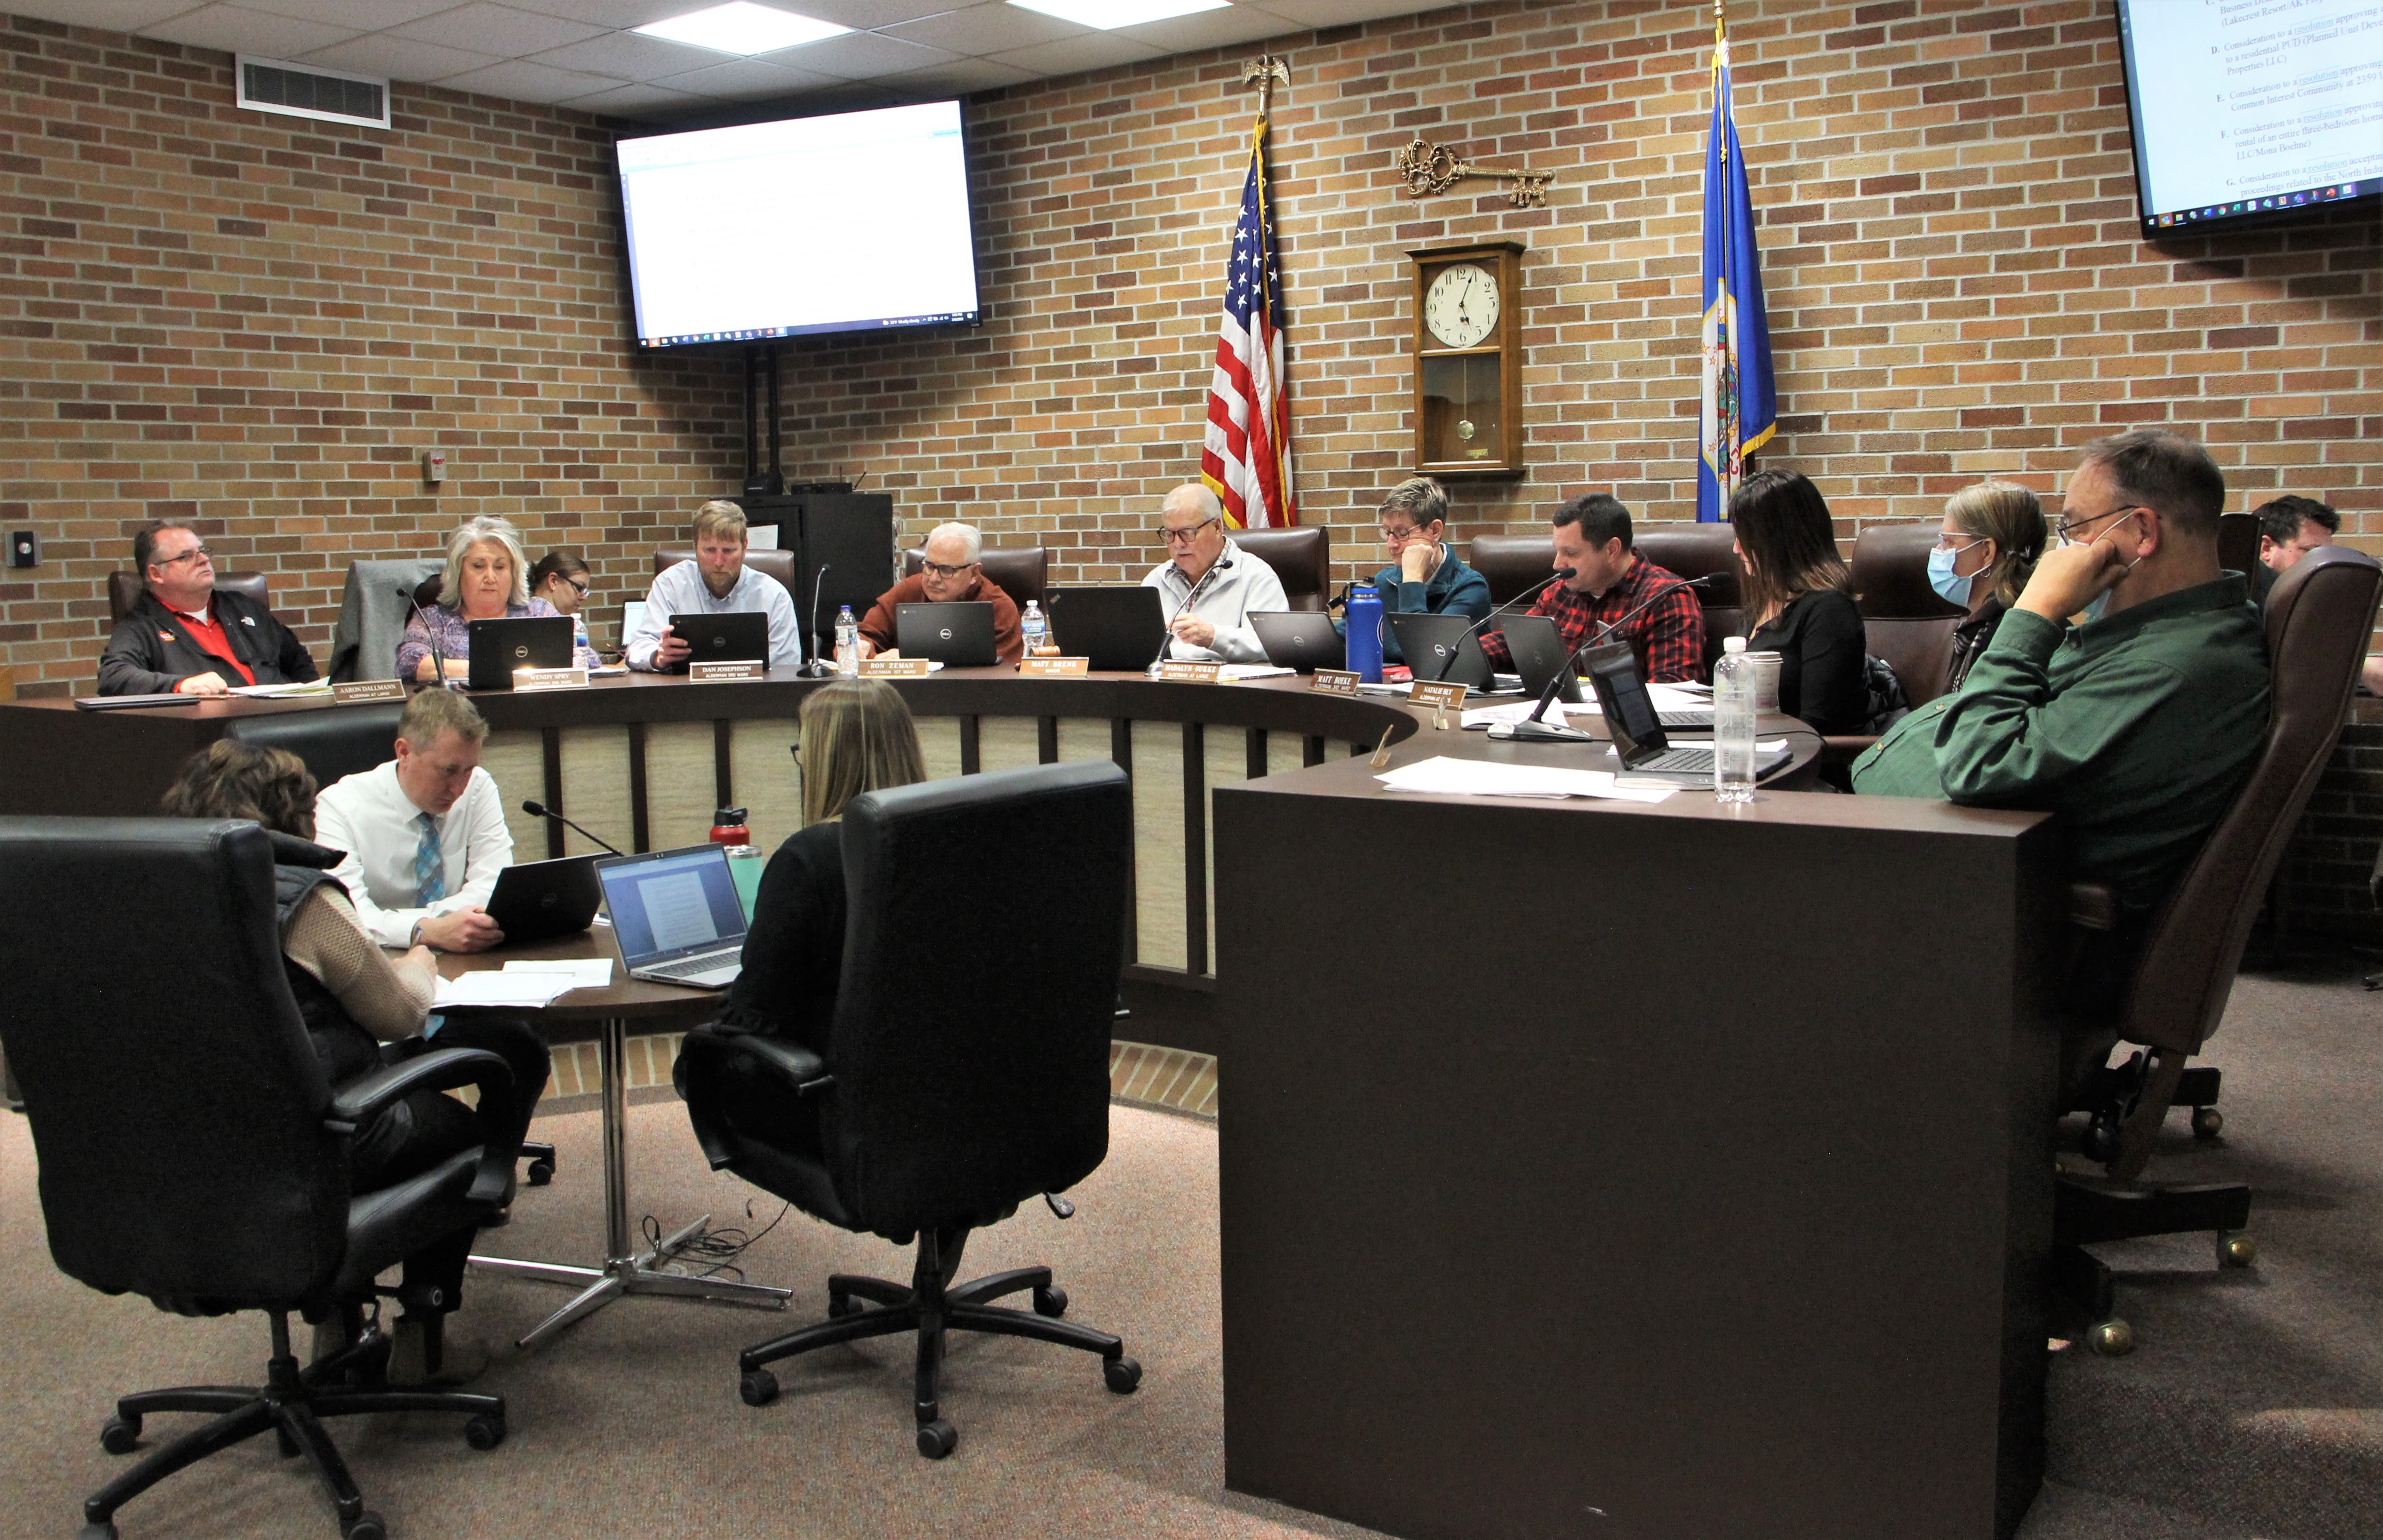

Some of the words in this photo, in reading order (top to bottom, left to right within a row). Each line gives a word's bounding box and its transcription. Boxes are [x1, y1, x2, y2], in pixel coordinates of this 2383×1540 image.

[2221, 1, 2253, 14] Business
[2222, 11, 2259, 27] (Lakecrest
[2224, 33, 2275, 51] Consideration
[2294, 18, 2334, 34] resolution
[2336, 8, 2378, 24] approving
[2241, 43, 2279, 60] residential
[2282, 37, 2300, 50] PUD
[2303, 28, 2338, 45] (Planned
[2341, 25, 2358, 35] Unit
[2227, 62, 2264, 75] Properties
[2266, 55, 2287, 66] LLC)
[2217, 94, 2225, 102] E.
[2229, 83, 2281, 99] Consideration
[2299, 70, 2339, 86] resolution
[2341, 60, 2383, 76] approving
[2231, 99, 2264, 111] Common
[2267, 92, 2295, 104] Interest
[2297, 82, 2344, 97] Community
[2356, 73, 2377, 85] 2359
[2221, 130, 2228, 138] F.
[2234, 120, 2285, 136] Consideration
[2303, 108, 2343, 123] resolution
[2235, 136, 2255, 148] rental
[2258, 135, 2266, 143] of
[2279, 129, 2300, 139] entire
[2302, 118, 2359, 135] three-bedroom
[2236, 147, 2277, 160] LLC/Mona
[2239, 169, 2290, 184] Consideration
[2308, 159, 2348, 172] resolution
[2241, 184, 2284, 198] proceedings
[2286, 176, 2312, 188] related
[2324, 173, 2336, 182] the
[2338, 168, 2361, 179] North
[1445, 274, 1451, 285] 11
[1457, 269, 1466, 280] 12
[1435, 287, 1443, 297] 10
[1484, 281, 1491, 293] 2
[1430, 304, 1437, 313] 9
[1434, 319, 1441, 329] 8
[1445, 328, 1451, 339] 7
[1459, 333, 1466, 342] 6
[1475, 325, 1481, 337] 5
[1317, 675, 1333, 683] MATT
[1334, 677, 1351, 685] BOEKE
[1423, 686, 1443, 694] NATALIE
